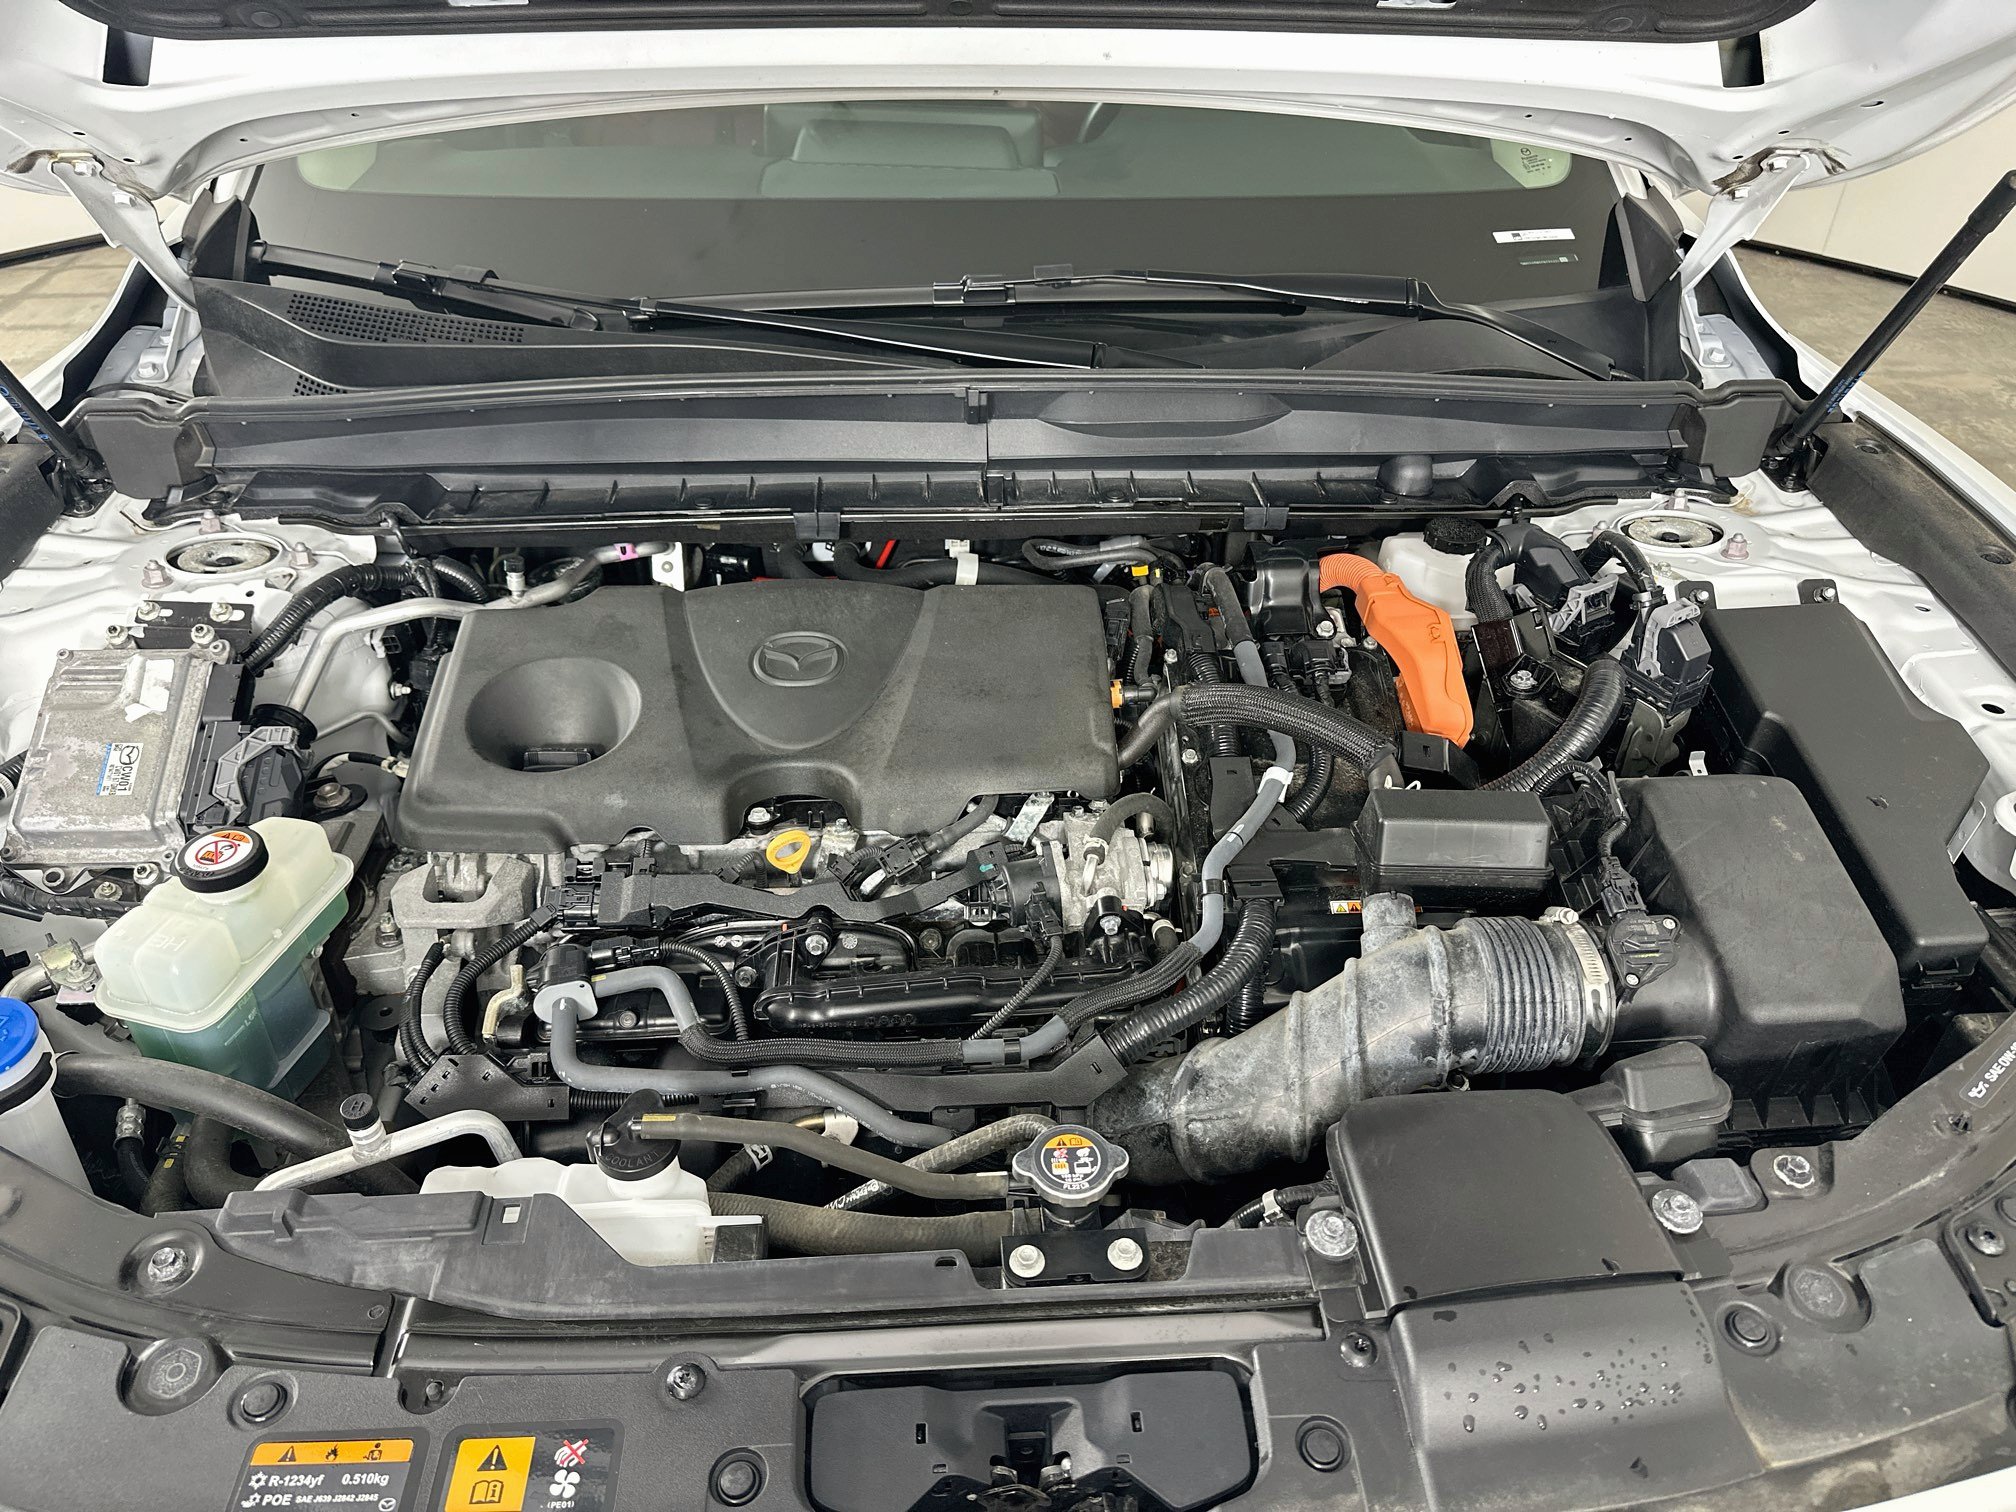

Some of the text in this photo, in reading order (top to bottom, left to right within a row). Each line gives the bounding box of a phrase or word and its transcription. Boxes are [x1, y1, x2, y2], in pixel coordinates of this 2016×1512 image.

[117, 766, 133, 791] CW01
[244, 1007, 258, 1027] LOW
[1984, 1062, 2006, 1082] SAE
[605, 1151, 660, 1168] COOLANT
[268, 1472, 390, 1488] R-1234yf 0.510kg
[261, 1493, 293, 1506] POE
[295, 1495, 313, 1504] SAE
[547, 1500, 575, 1509] (PE01)
